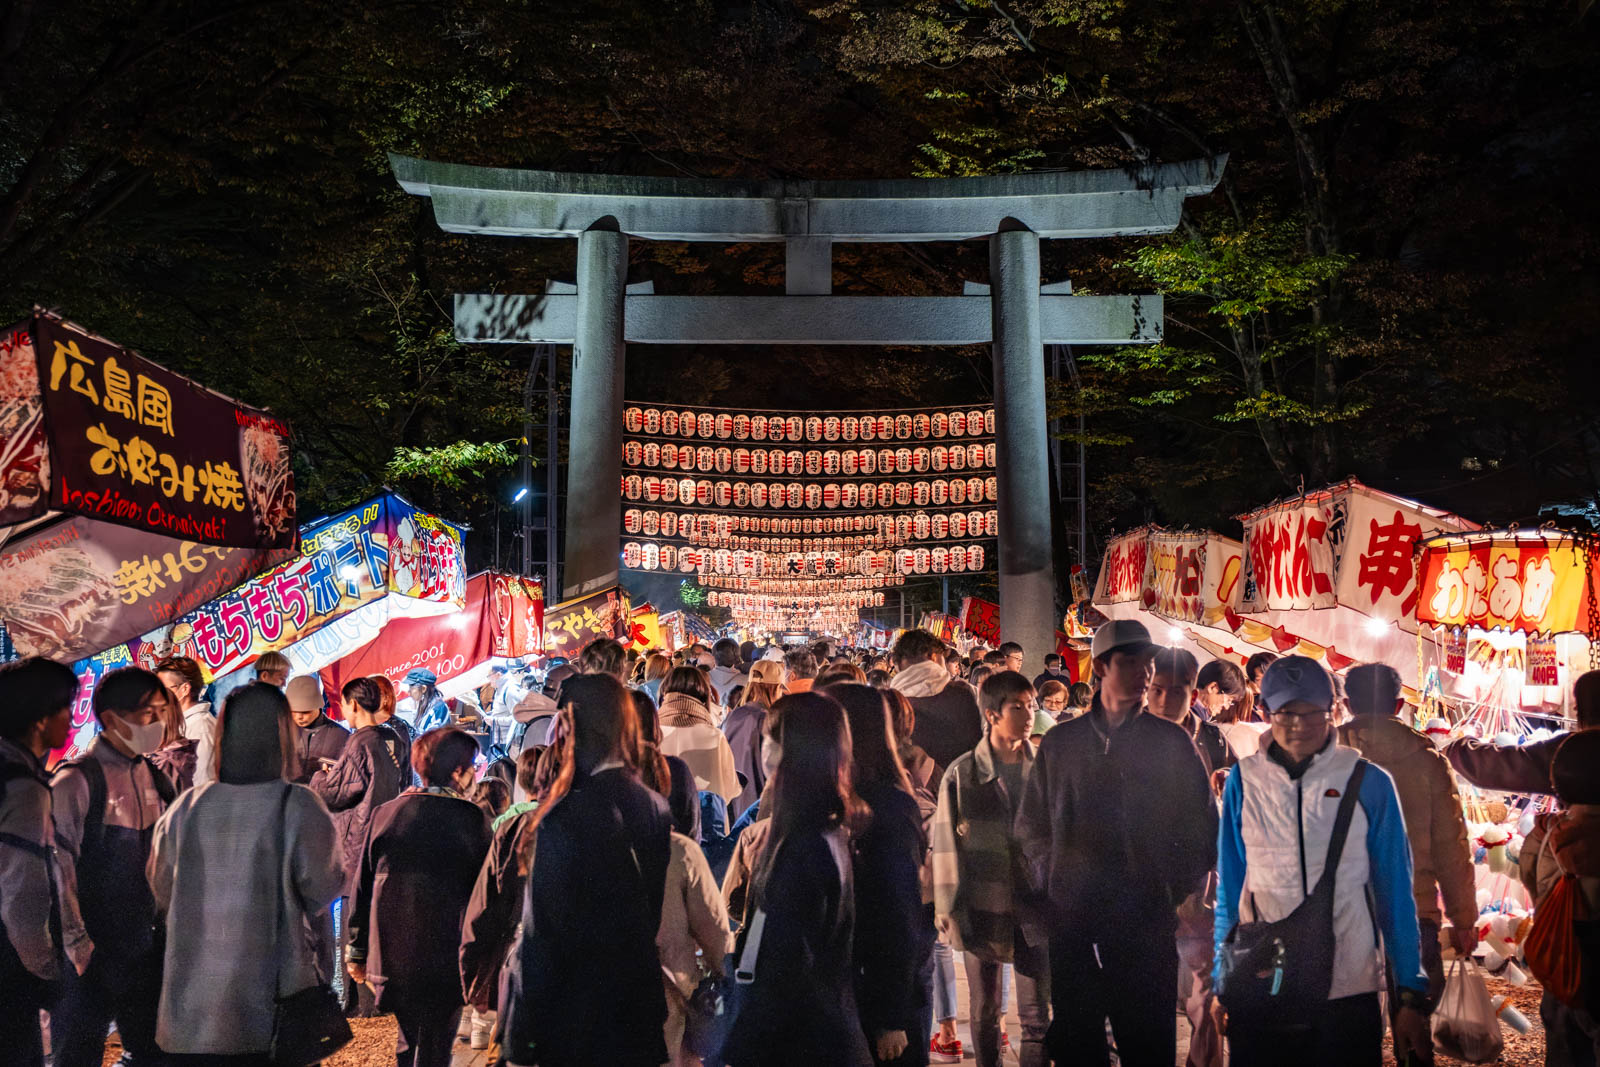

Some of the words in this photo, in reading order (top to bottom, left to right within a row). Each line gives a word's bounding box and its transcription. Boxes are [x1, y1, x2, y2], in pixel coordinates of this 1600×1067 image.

[50, 340, 175, 437] 広島風
[86, 422, 245, 511] お好み焼
[191, 530, 388, 668] もちもちポテト
[787, 559, 800, 575] 大
[1430, 554, 1556, 621] わたあめ
[384, 661, 412, 678] since
[411, 642, 445, 667] 2001
[544, 606, 601, 651] こやき
